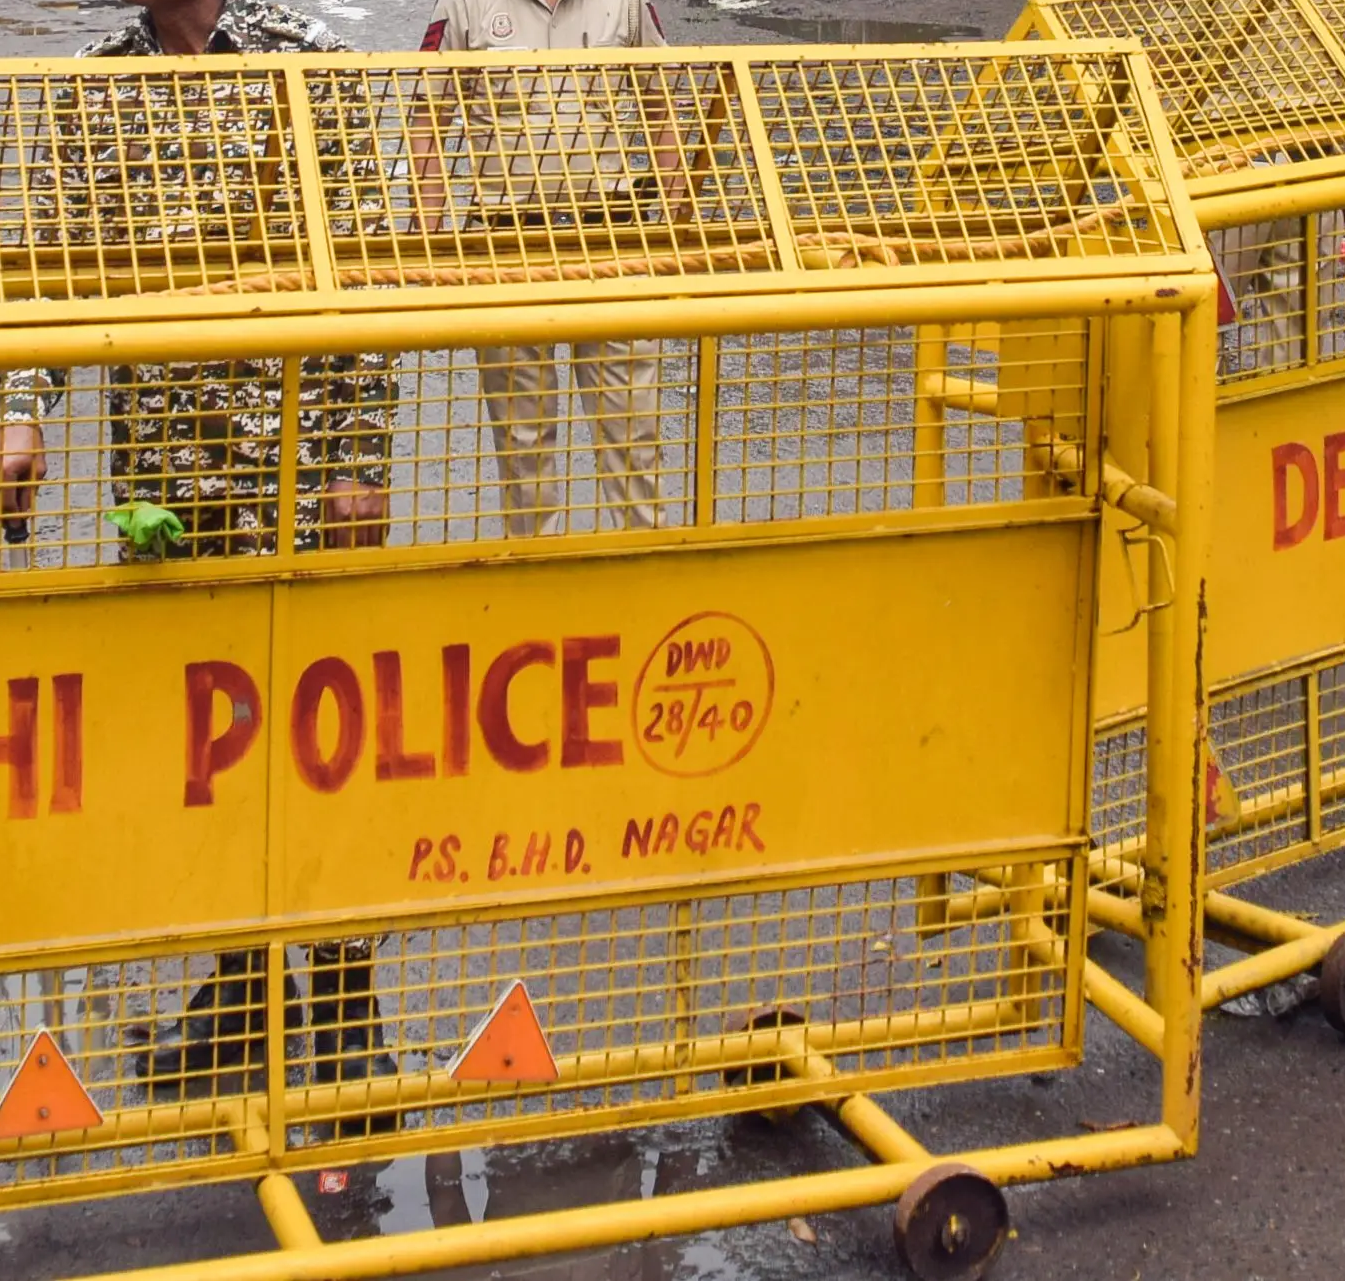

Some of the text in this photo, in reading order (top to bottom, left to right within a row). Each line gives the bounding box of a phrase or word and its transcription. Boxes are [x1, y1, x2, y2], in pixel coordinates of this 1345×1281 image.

[665, 638, 733, 678] DWD
[184, 634, 625, 809] POLICE
[642, 685, 756, 759] 28/40
[621, 803, 766, 860] NAGAR
